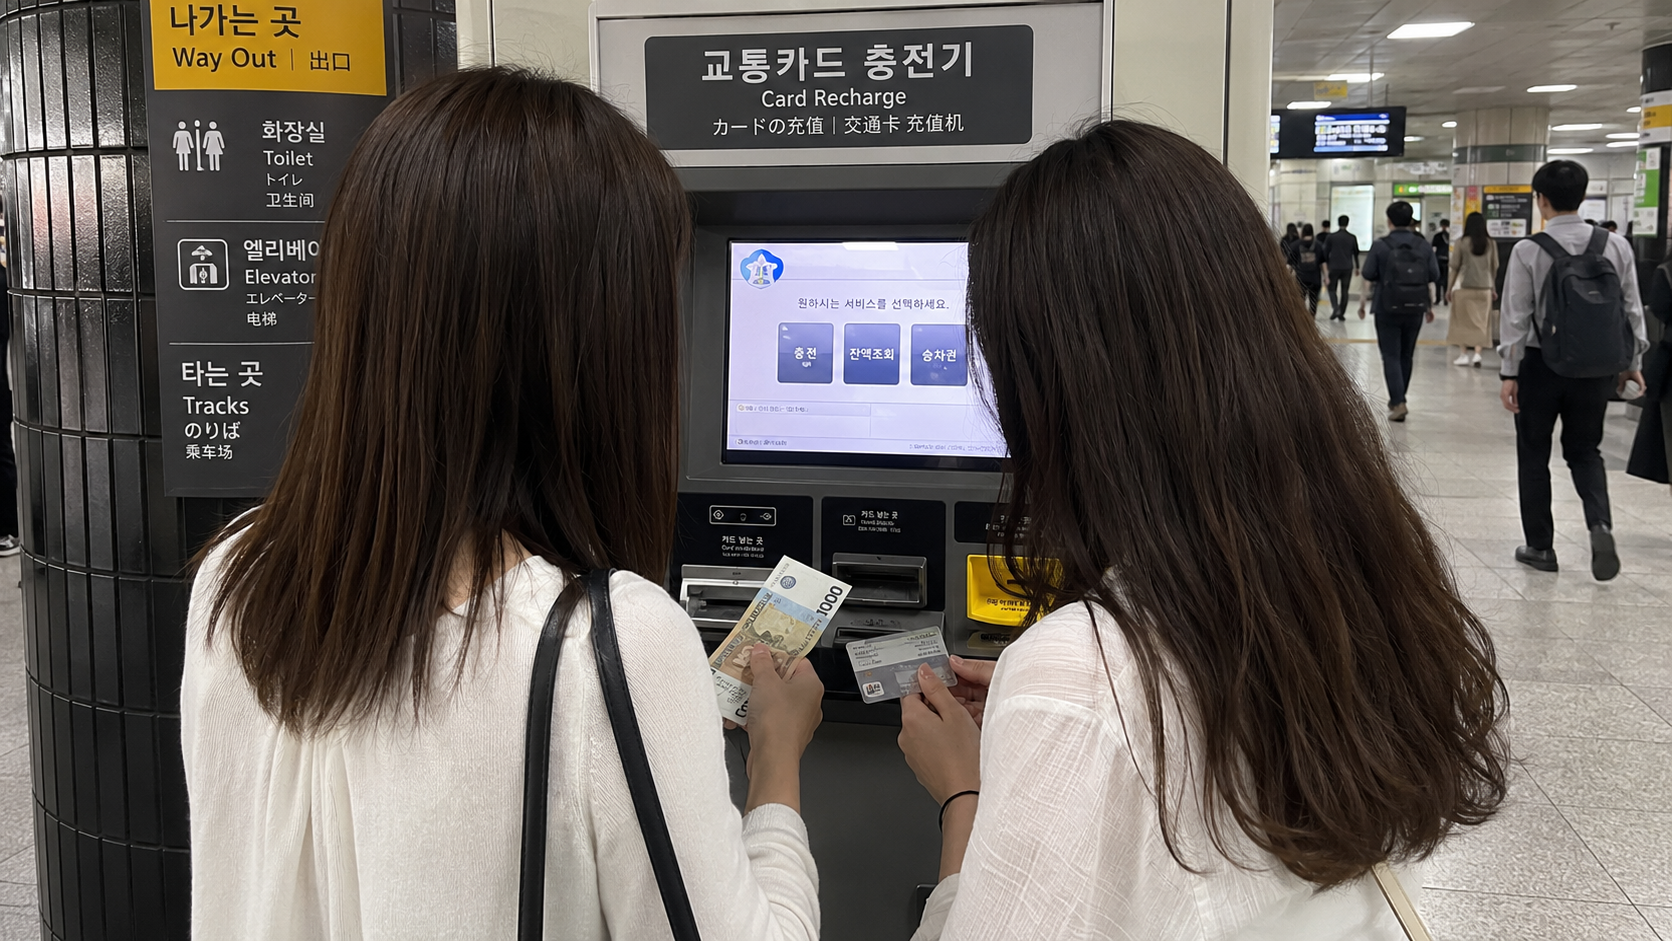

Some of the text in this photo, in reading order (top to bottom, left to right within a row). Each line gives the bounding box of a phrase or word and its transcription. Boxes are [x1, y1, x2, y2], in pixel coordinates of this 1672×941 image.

[170, 3, 302, 39] 나가는 곳
[172, 47, 277, 73] Way Out
[310, 50, 351, 72] 出口
[701, 41, 973, 84] 교통카드 충전기
[761, 87, 907, 109] Card Recharge
[262, 120, 326, 144] 화장실
[263, 150, 314, 167] Toilet
[266, 172, 303, 186] トイレ
[266, 192, 314, 208] 卫生间
[245, 268, 317, 285] Elevator
[246, 292, 316, 305] エレベーター
[798, 297, 840, 310] 원하시는
[844, 298, 887, 310] 서비스를
[247, 311, 278, 327] 电梯
[849, 347, 895, 361] 잔액조회
[181, 360, 264, 387] 타는 곳
[183, 395, 249, 415] Tracks
[184, 421, 241, 440] のりば
[185, 443, 233, 460] 乘车场
[816, 585, 843, 616] 1000
